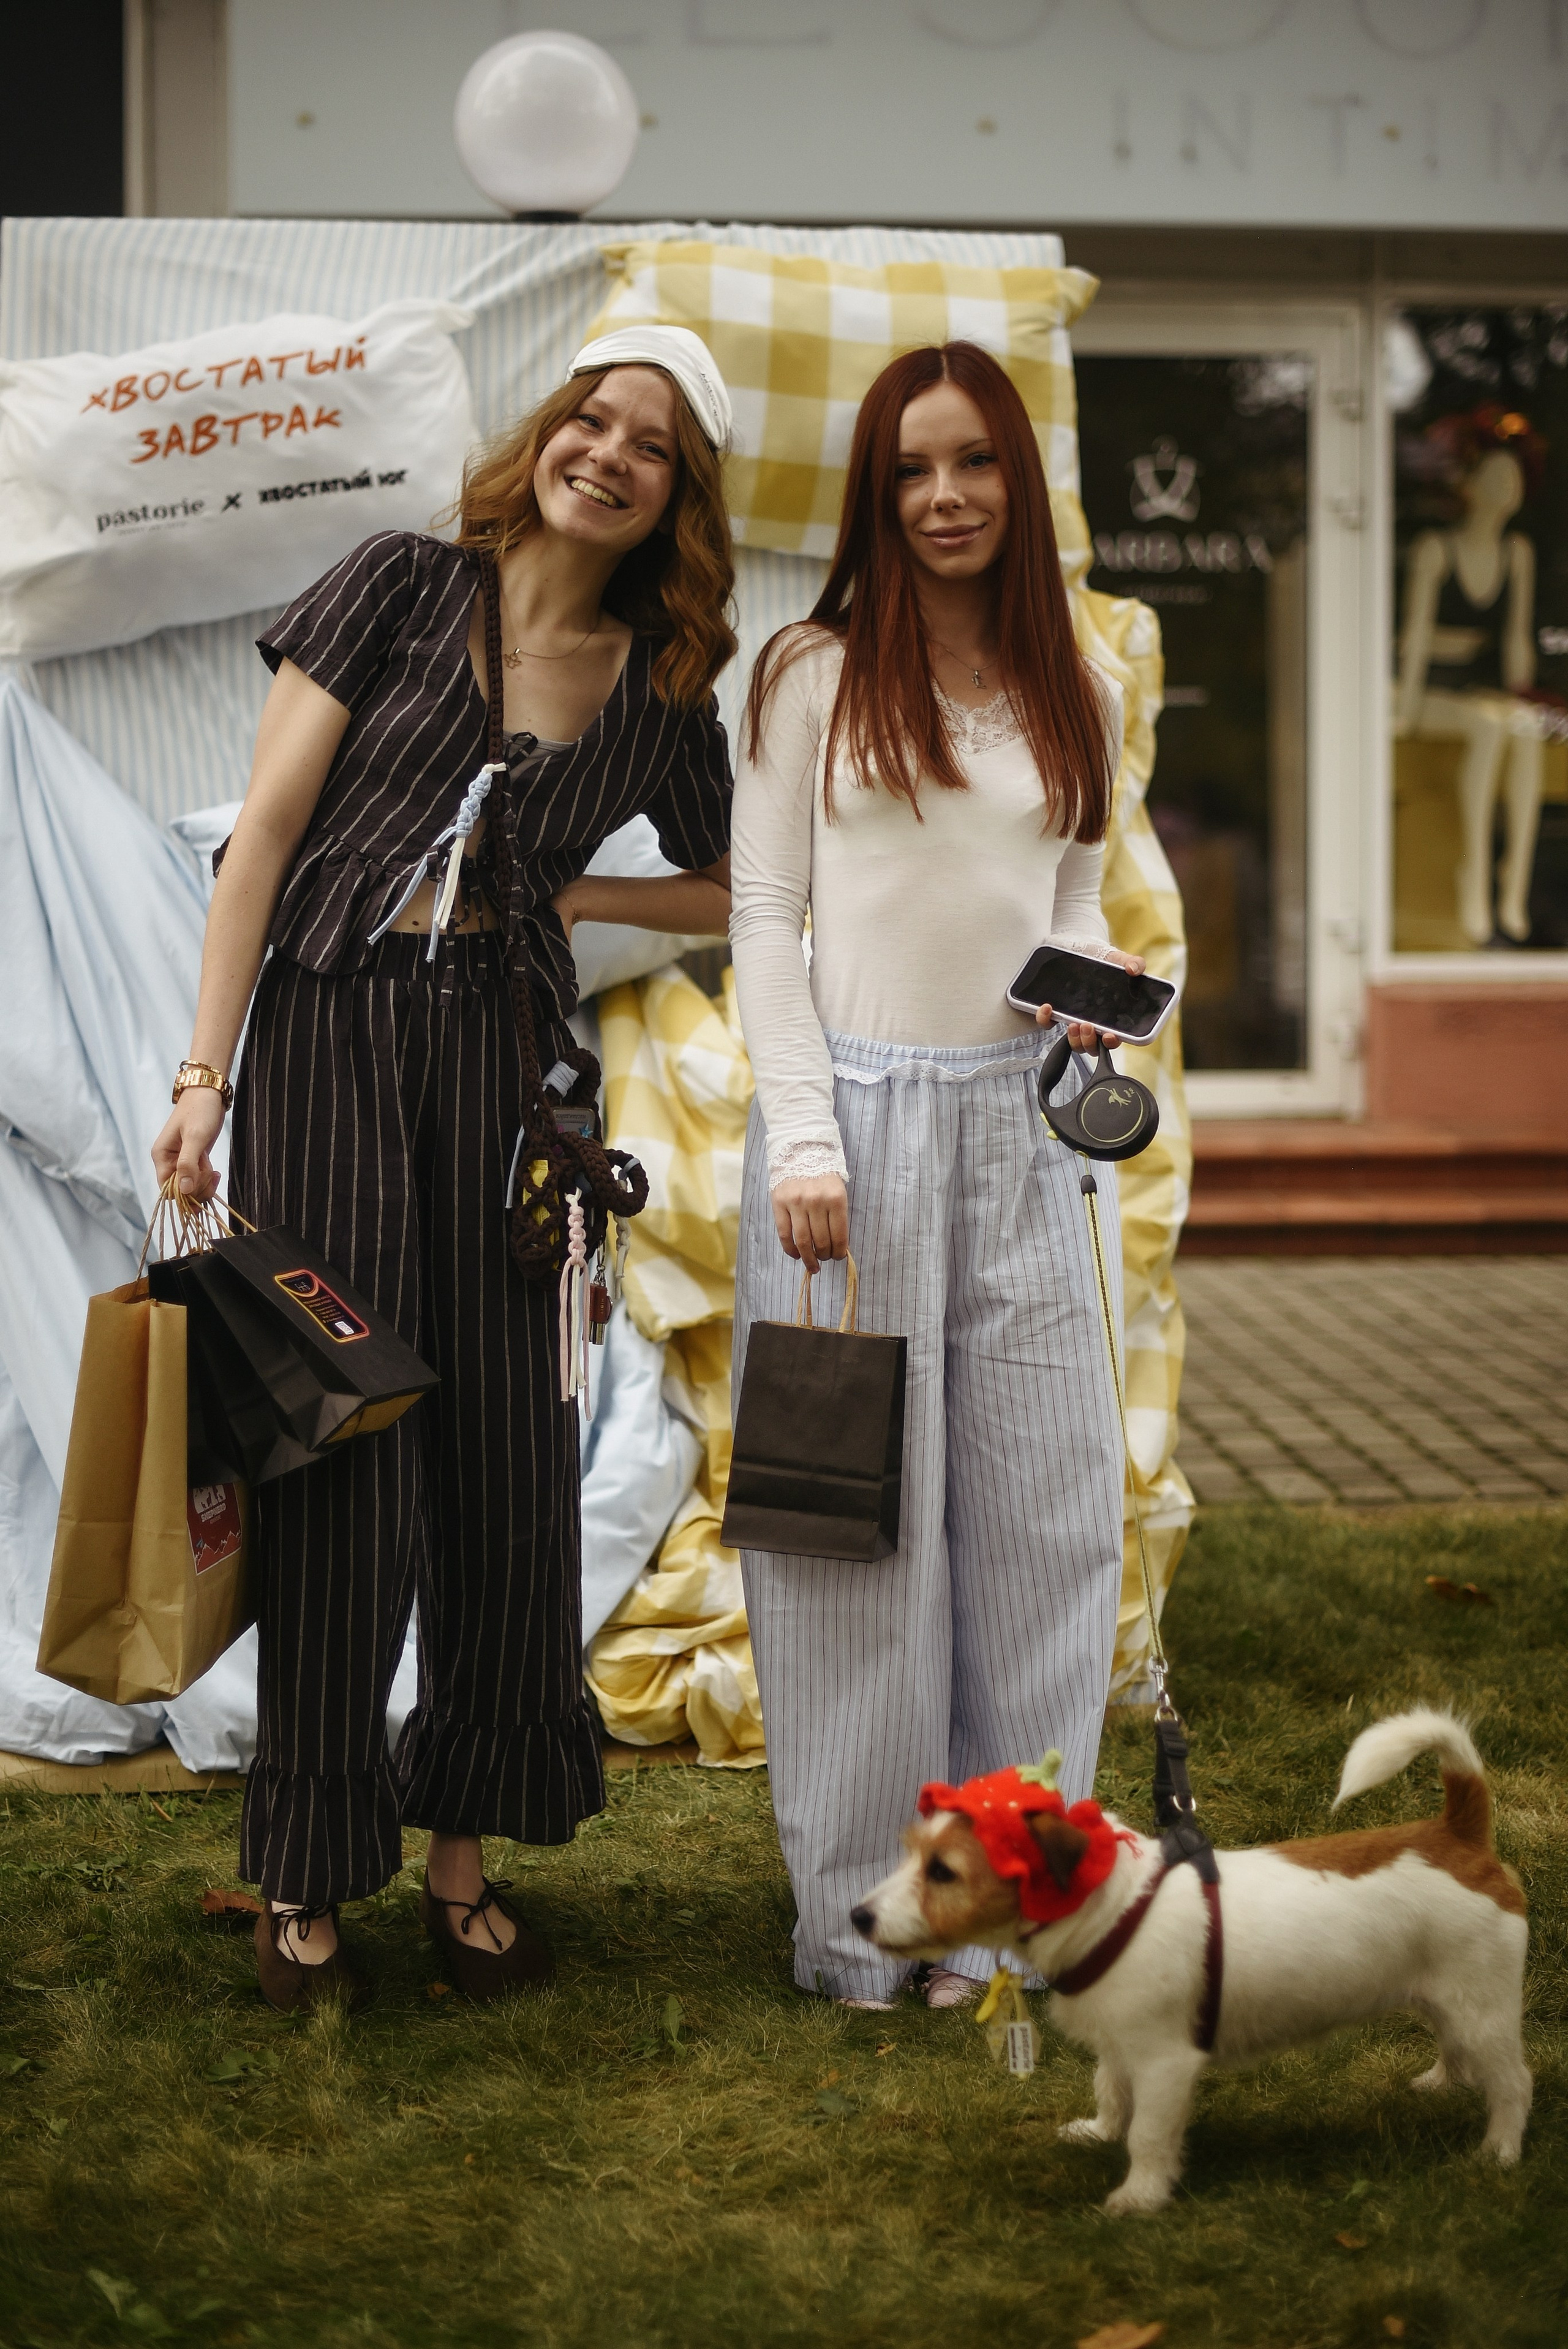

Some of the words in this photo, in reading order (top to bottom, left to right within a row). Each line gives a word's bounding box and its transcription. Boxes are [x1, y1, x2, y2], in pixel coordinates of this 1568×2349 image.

[130, 403, 342, 464] ЗАВТРАК
[95, 497, 206, 533] pastorie
[258, 468, 374, 505] ХВОСТАТЫЙ
[377, 469, 409, 488] ЮГ
[200, 1502, 227, 1523] SHEPHERD
